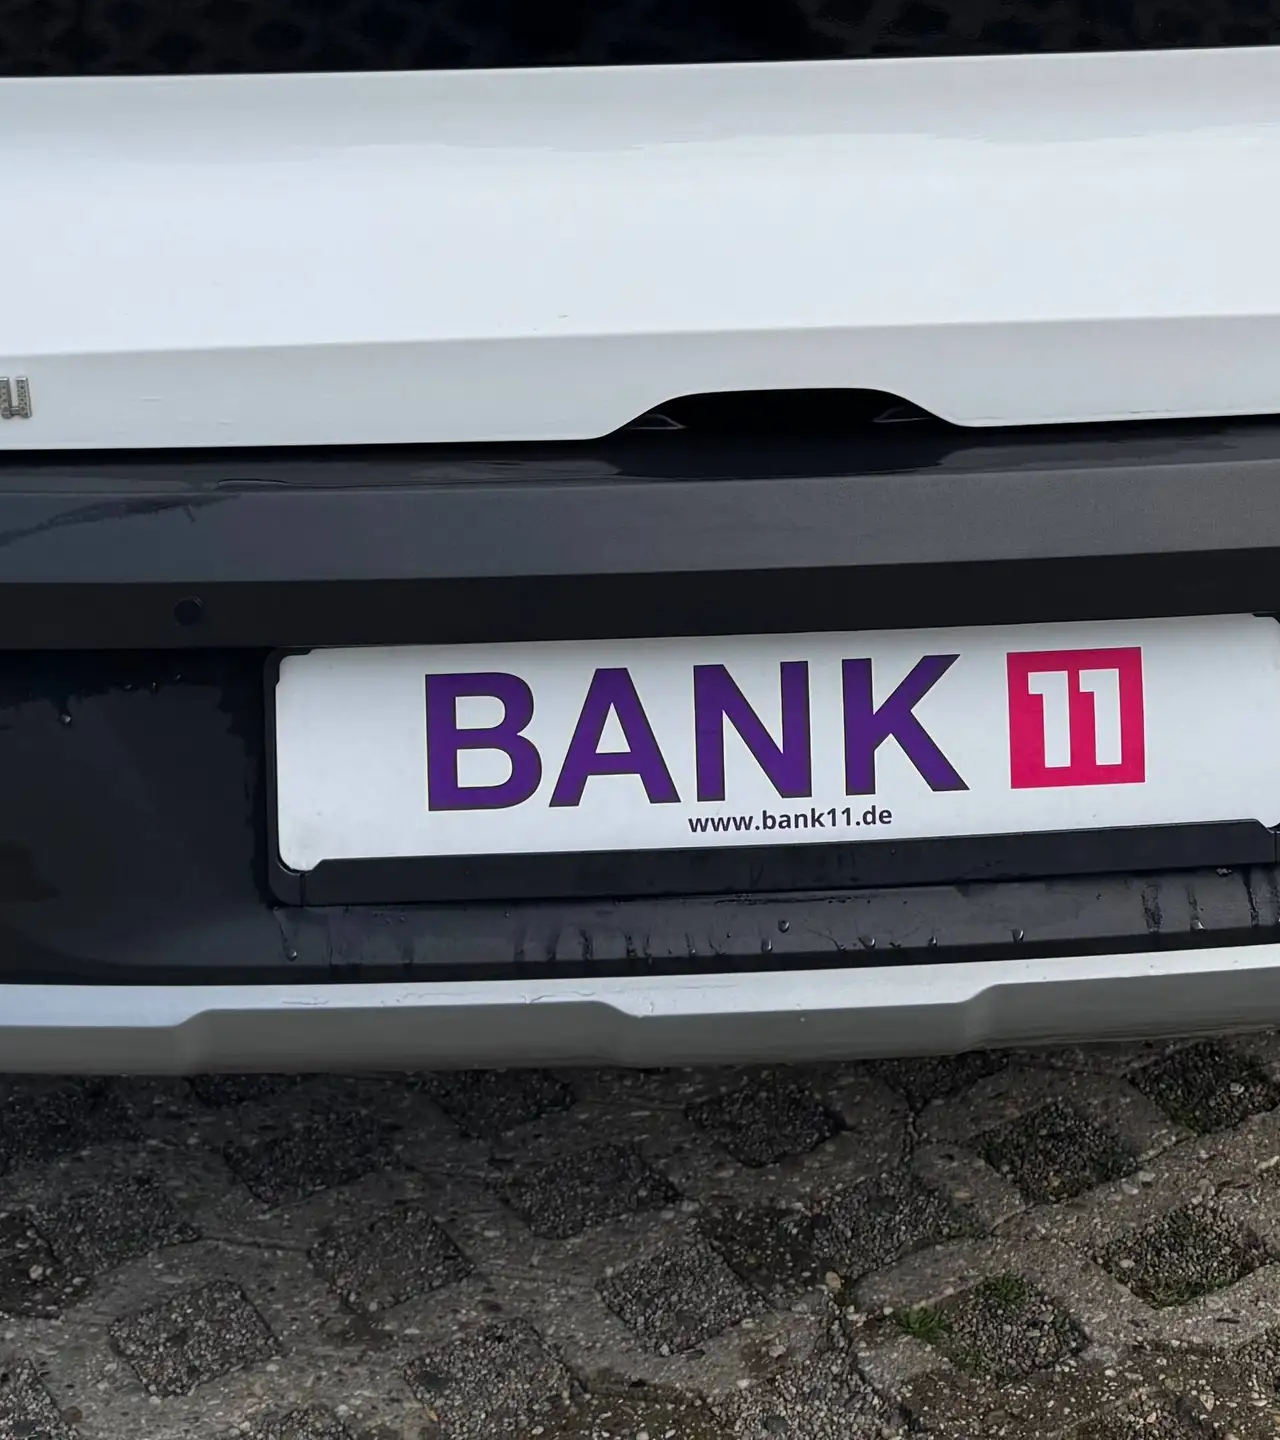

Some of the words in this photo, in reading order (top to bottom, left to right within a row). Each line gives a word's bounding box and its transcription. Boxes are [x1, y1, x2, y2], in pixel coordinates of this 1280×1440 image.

[424, 653, 971, 812] BANK
[1024, 664, 1126, 772] 11
[688, 804, 893, 833] www.bank11.de
